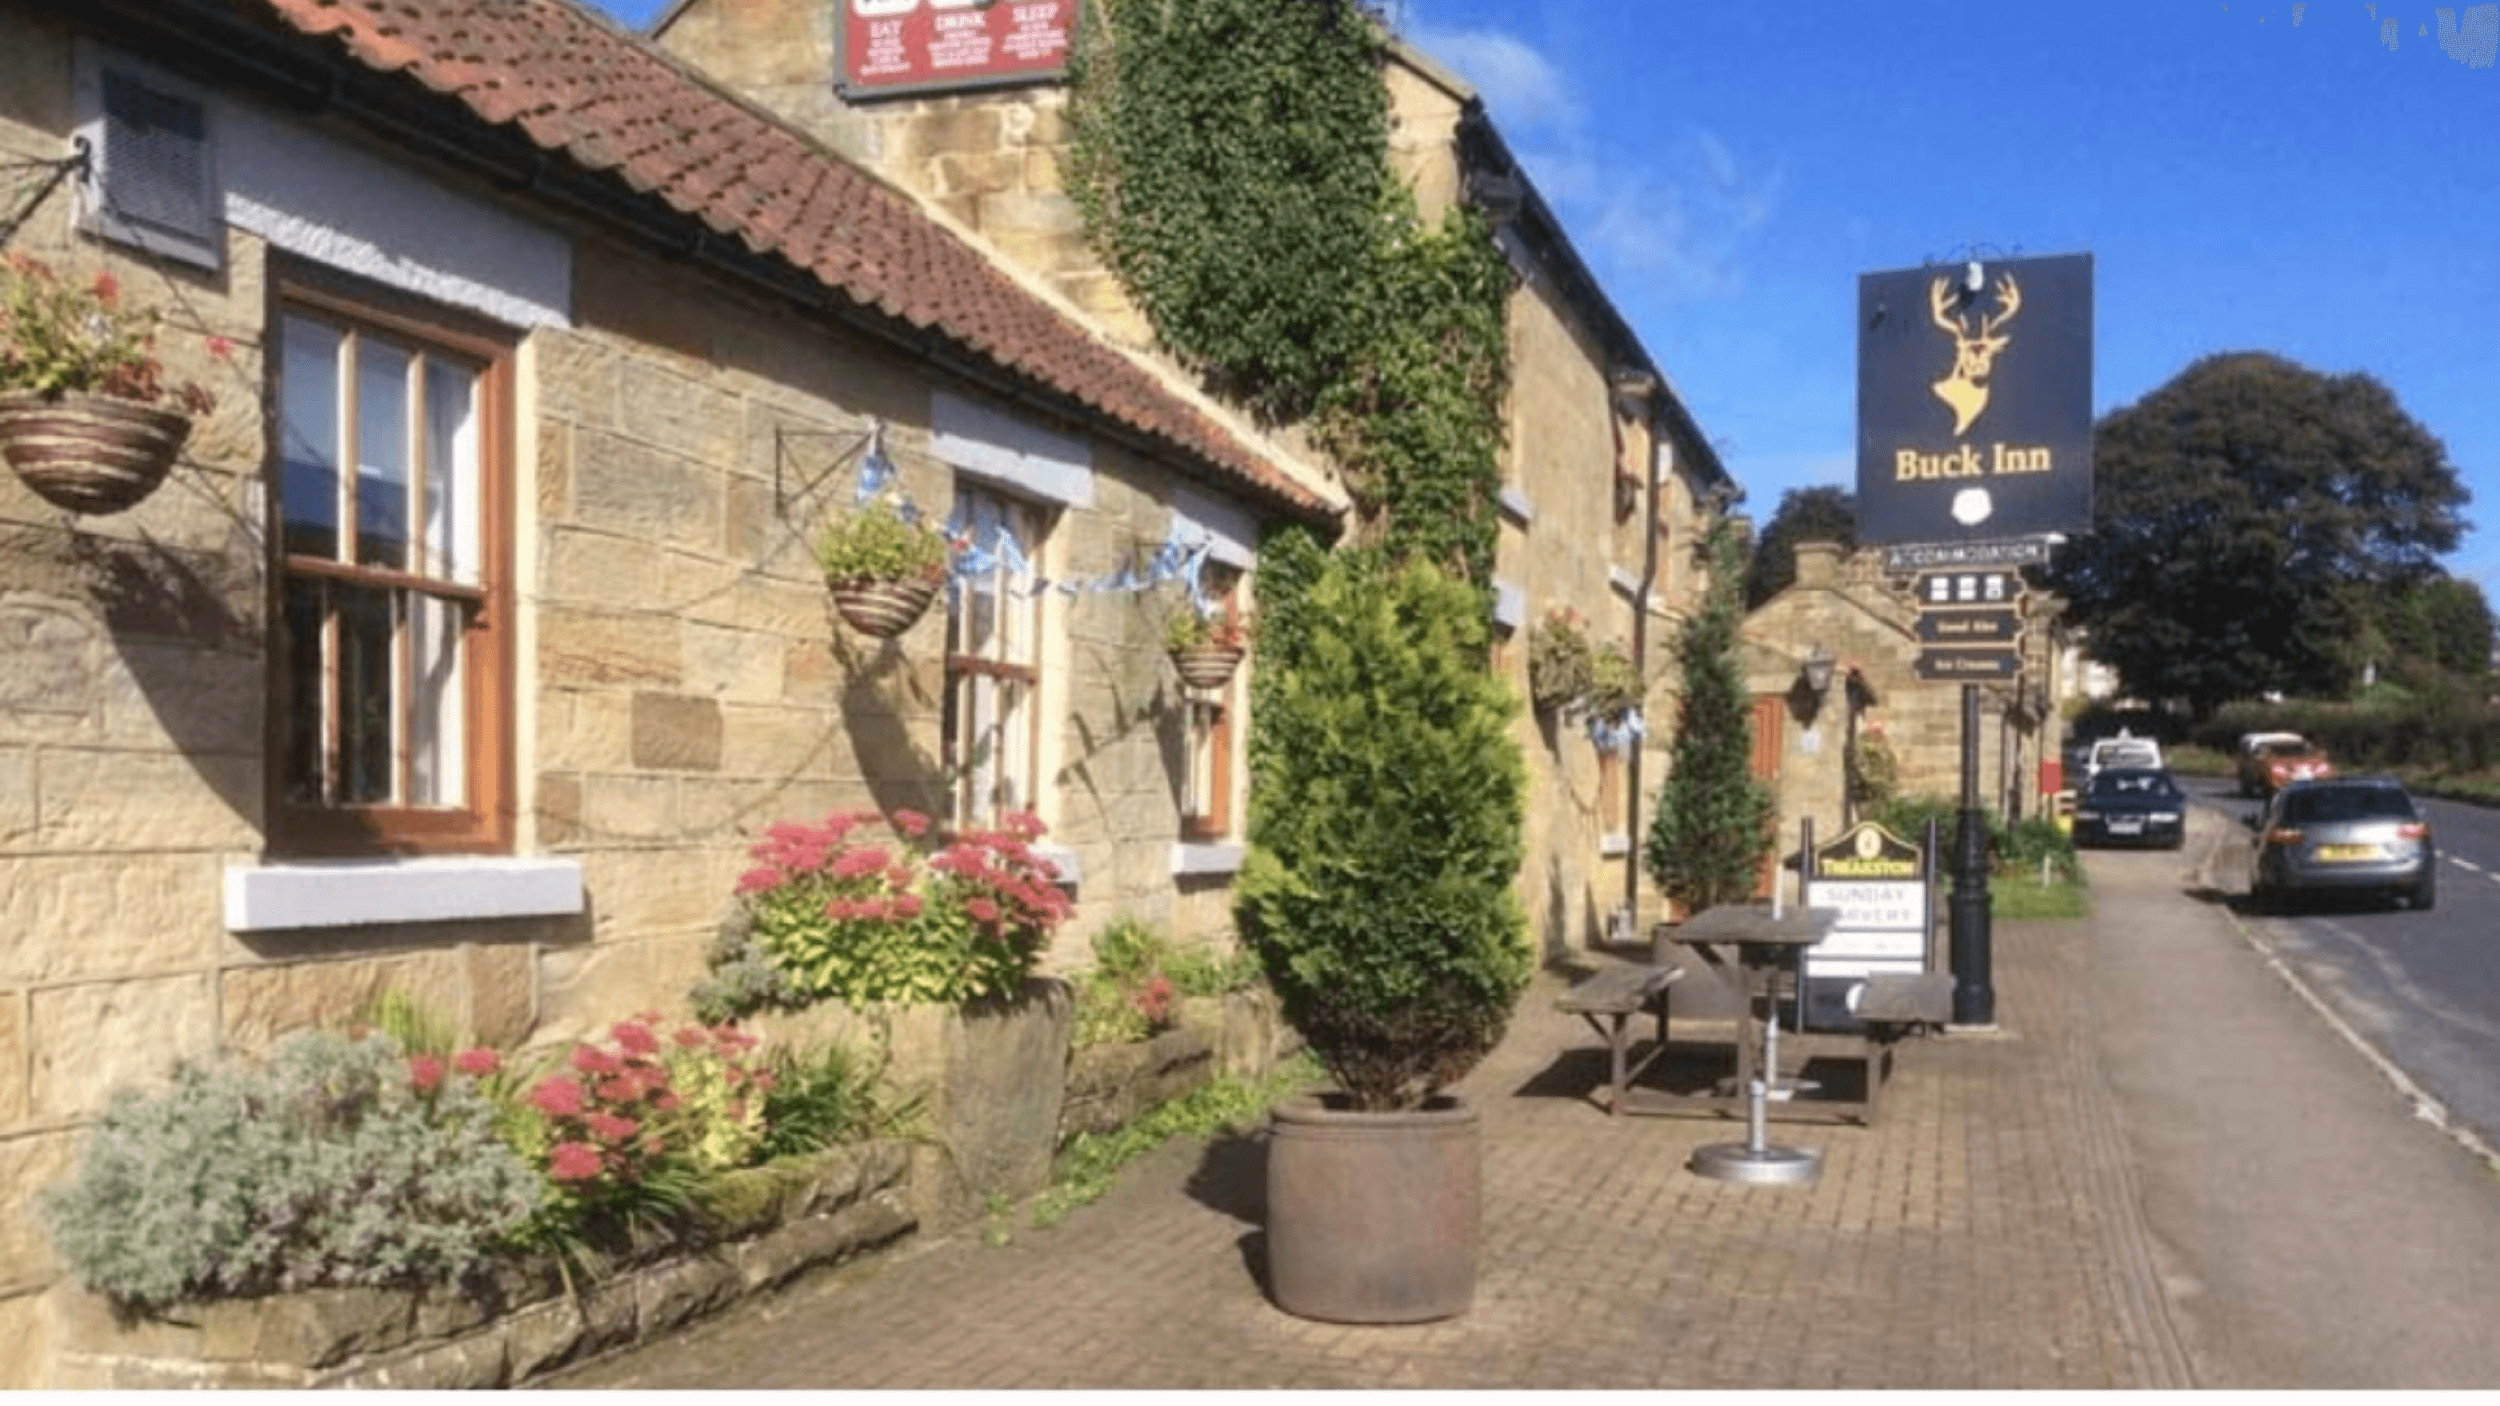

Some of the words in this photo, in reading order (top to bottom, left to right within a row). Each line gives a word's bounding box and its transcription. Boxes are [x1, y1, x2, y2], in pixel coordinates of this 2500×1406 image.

[1896, 444, 1983, 481] Buck
[1992, 443, 2052, 474] Inn
[1826, 887, 1905, 902] SUNDAY
